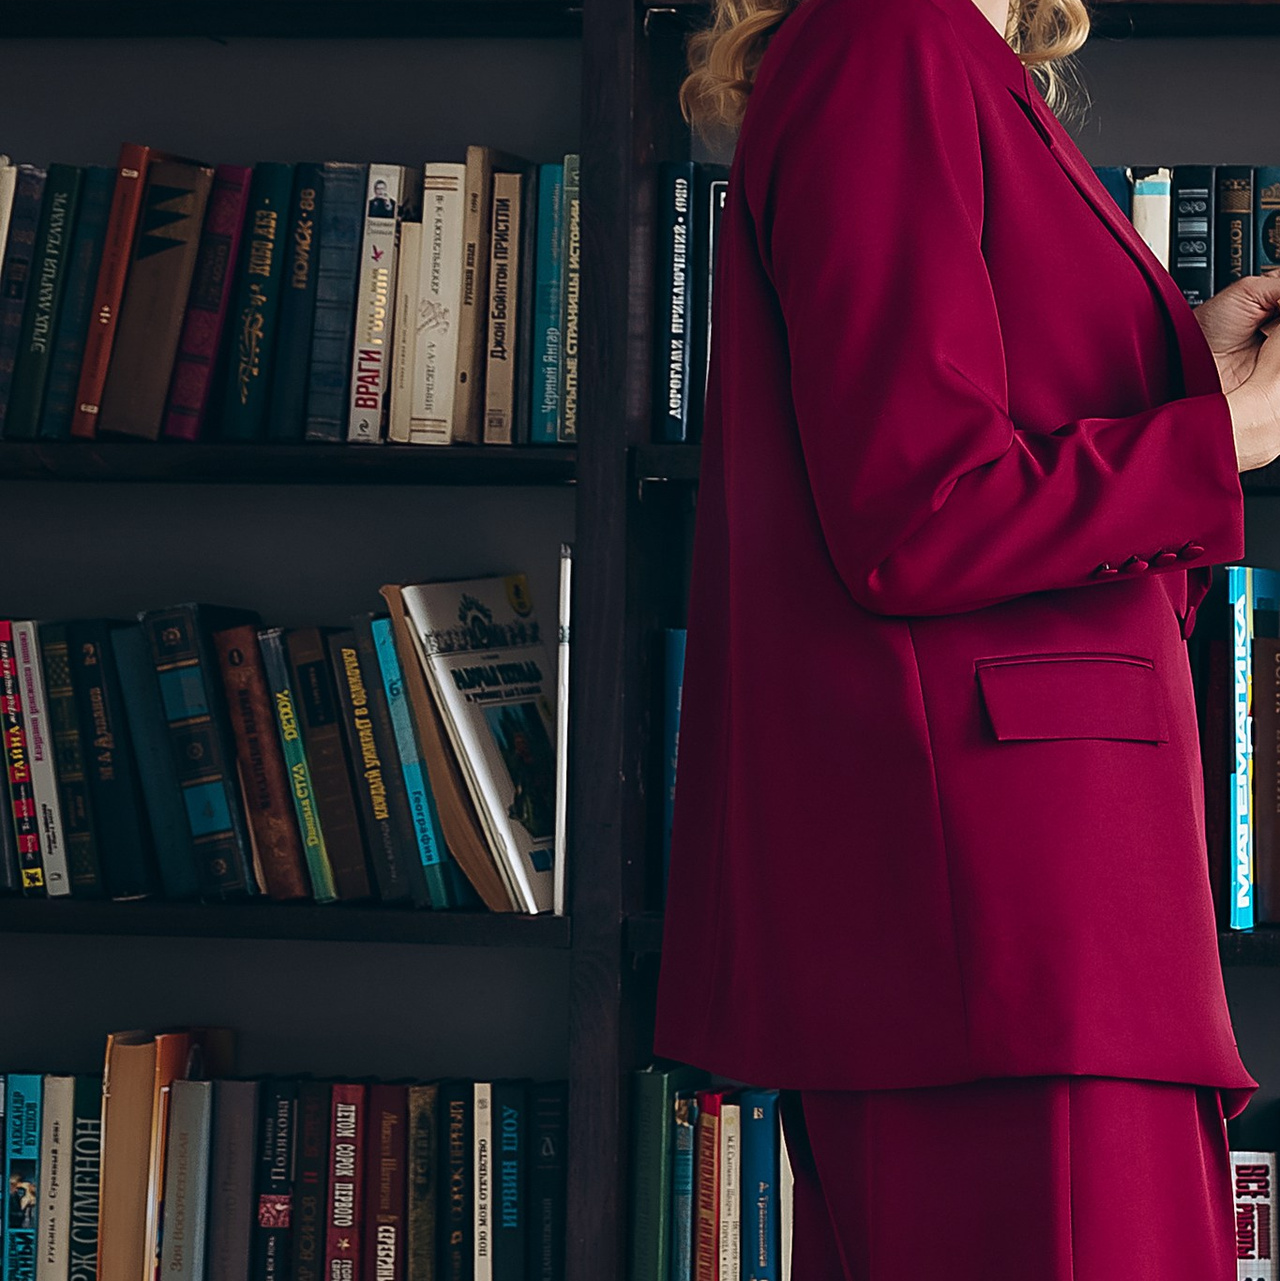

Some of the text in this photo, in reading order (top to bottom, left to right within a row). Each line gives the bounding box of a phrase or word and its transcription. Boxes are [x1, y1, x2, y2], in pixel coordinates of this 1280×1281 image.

[30, 192, 69, 354] ЭРИХ МАРИЯ РЕМАРК
[490, 198, 511, 361] Джон Бойнтон ПРИСТЛИ
[354, 349, 382, 410] ВРАГИ
[539, 326, 560, 413] Черный Янгар
[340, 648, 368, 707] ОДИНОЧКУ
[363, 769, 390, 821] КАЖДЫЙ
[1235, 593, 1251, 909] МАТЕМАТИКА
[411, 789, 434, 863] География
[72, 1116, 101, 1244] СИМЕНОН
[270, 1097, 290, 1182] Полякова
[333, 1102, 357, 1228] ЛЕТОМ СОРОК ПЕРВОГО
[501, 1104, 520, 1229] ИРВИН ШОУ
[698, 1124, 716, 1212] МАЯКОВСКИЙ
